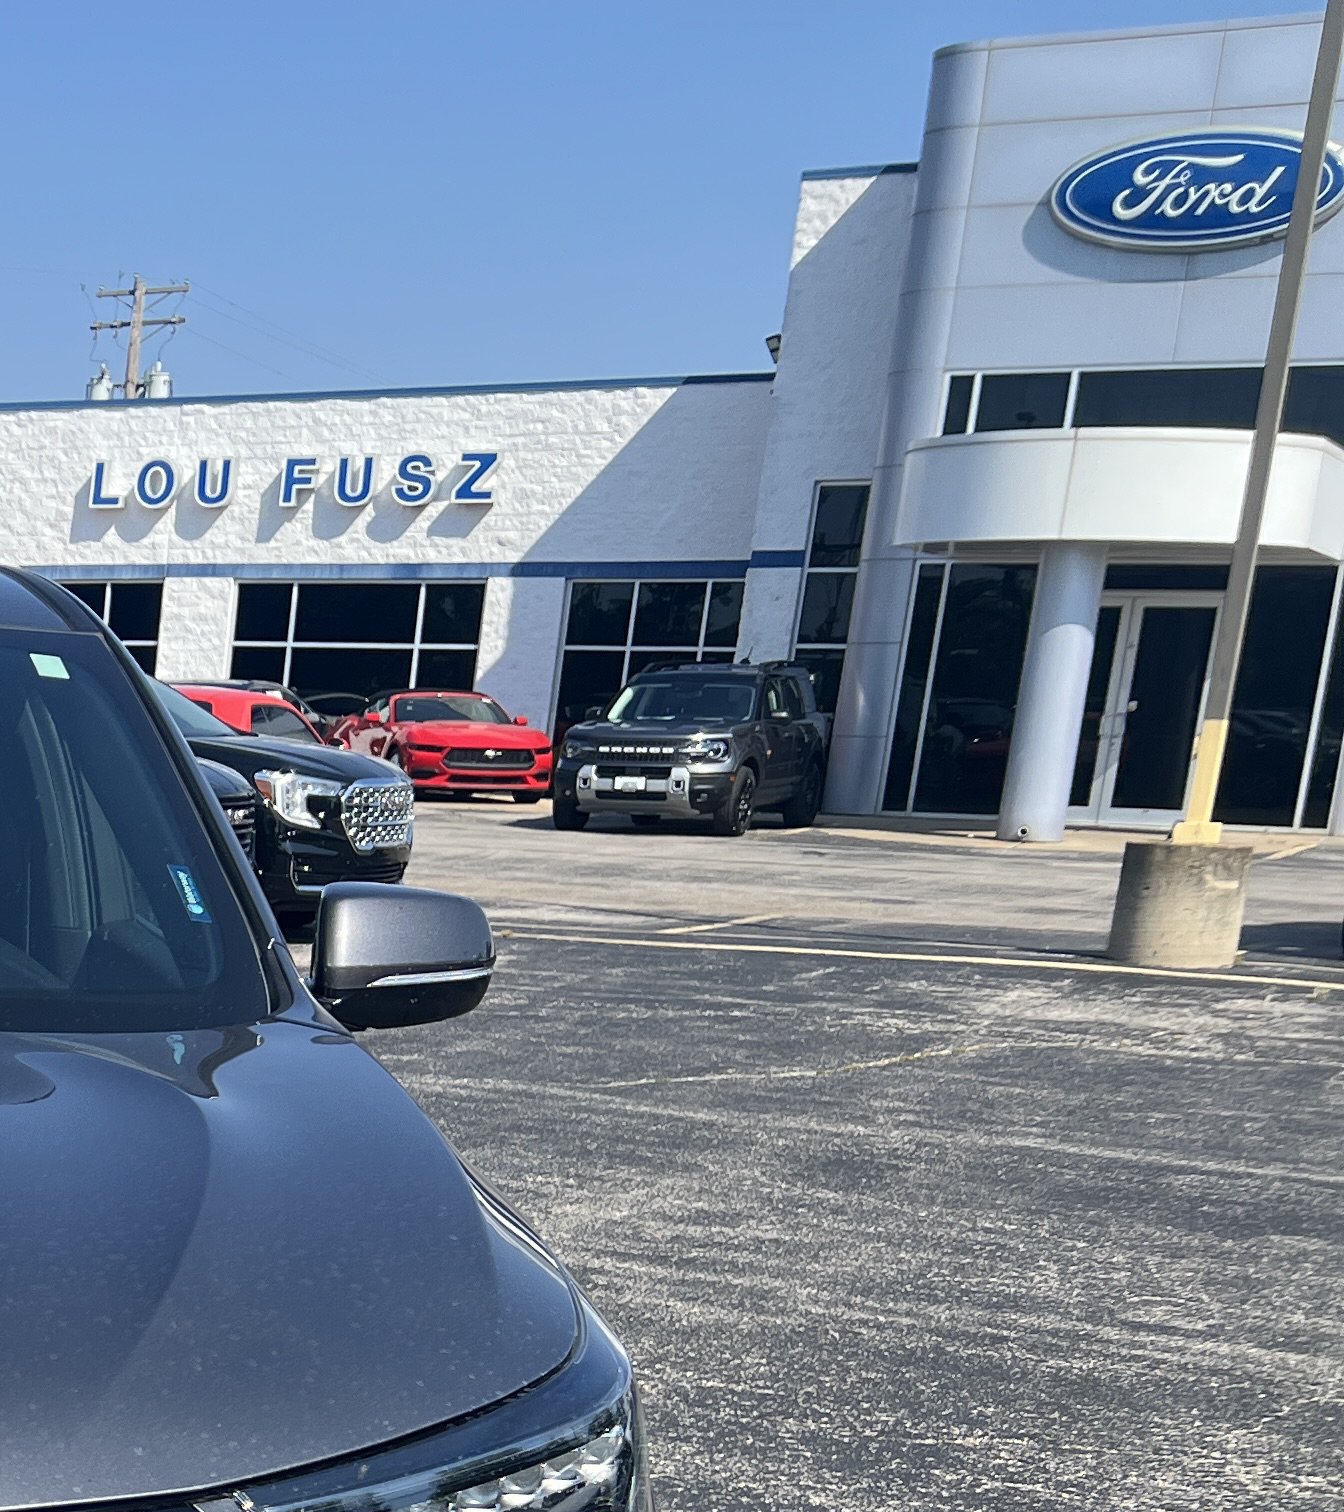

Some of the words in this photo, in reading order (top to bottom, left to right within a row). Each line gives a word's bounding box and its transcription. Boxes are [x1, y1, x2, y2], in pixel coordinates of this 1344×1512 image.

[1111, 152, 1287, 221] Ford
[90, 457, 232, 507] LOU
[280, 451, 500, 506] FUSZ
